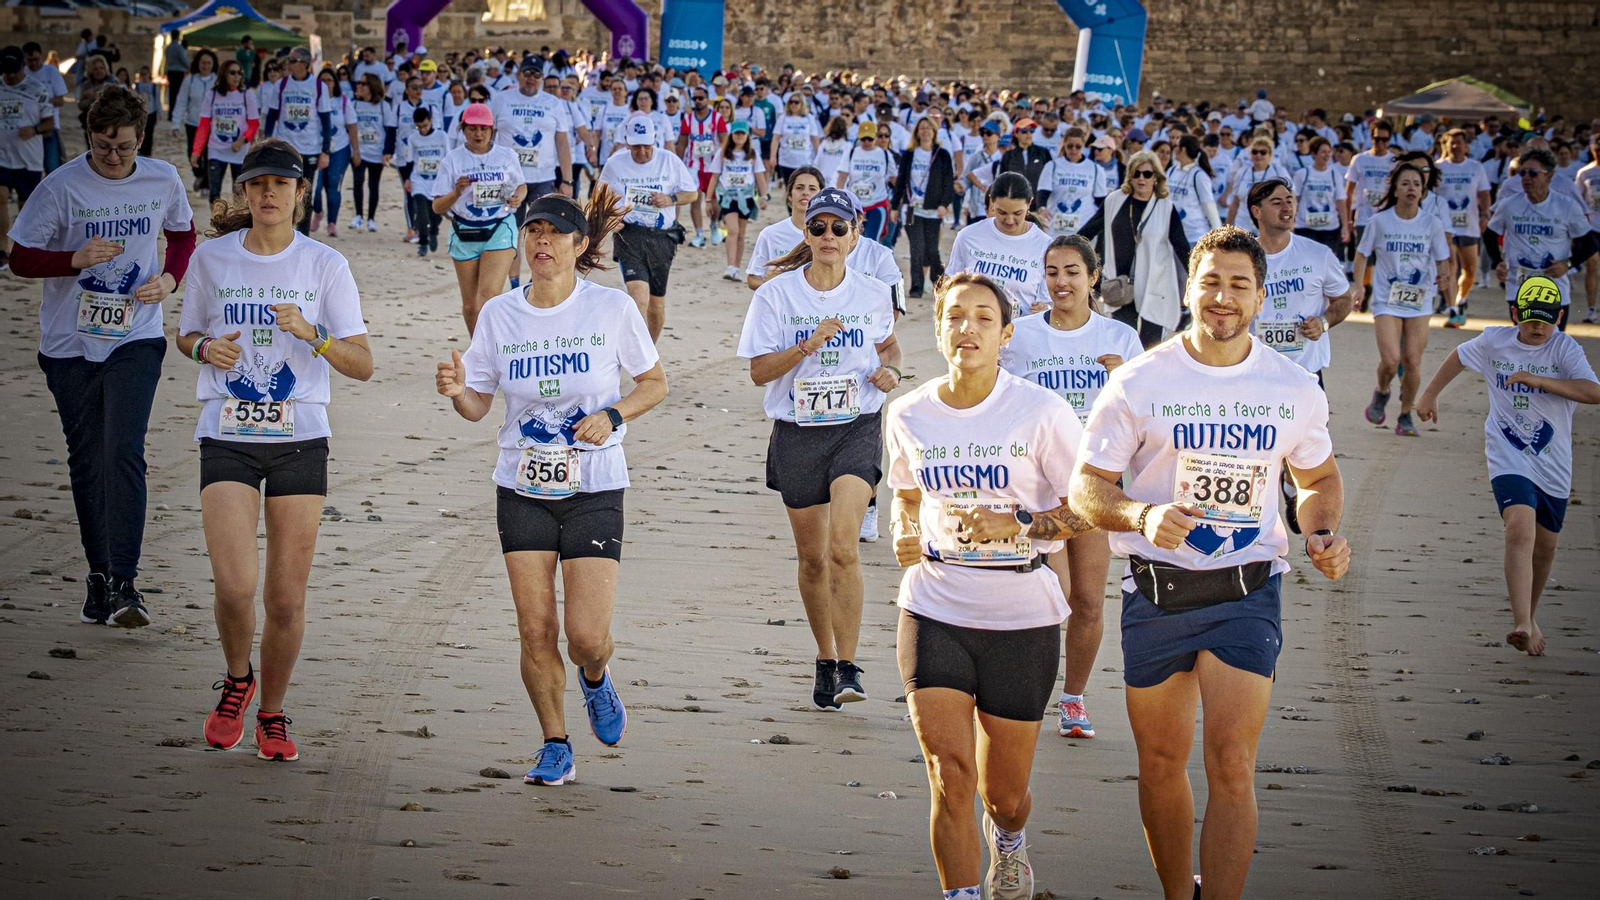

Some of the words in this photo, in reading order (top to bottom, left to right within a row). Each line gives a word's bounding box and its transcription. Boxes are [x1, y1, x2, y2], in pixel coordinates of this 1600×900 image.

[512, 109, 545, 118] AUTISMO
[79, 207, 110, 218] marcha
[114, 206, 120, 215] a
[123, 202, 147, 214] favor
[151, 199, 161, 211] del
[85, 216, 151, 239] AUTISMO
[1514, 224, 1554, 236] AUTISMO
[1386, 241, 1425, 253] AUTISMO
[974, 250, 997, 260] marcha
[1008, 255, 1027, 266] favor
[974, 260, 1028, 283] AUTISMO
[1281, 268, 1299, 277] favor
[1302, 264, 1313, 274] del
[218, 285, 253, 299] marcha
[258, 287, 265, 298] a
[270, 285, 299, 299] favor
[1397, 290, 1418, 302] 123
[1520, 286, 1558, 304] 46
[90, 305, 124, 325] 709
[791, 313, 819, 325] marcha
[864, 313, 872, 325] del
[503, 340, 538, 355] marcha
[543, 339, 550, 350] a
[555, 335, 585, 349] favor
[591, 333, 605, 346] del
[1265, 330, 1295, 343] 806
[509, 352, 590, 381] AUTISMO
[1032, 354, 1064, 369] marcha
[1069, 356, 1075, 365] a
[1079, 354, 1097, 366] fav
[1527, 363, 1548, 374] favor
[1038, 369, 1109, 390] AUTISMO
[808, 389, 847, 411] 717
[236, 400, 281, 423] 555
[1162, 401, 1211, 418] marcha
[1219, 404, 1226, 417] a
[1234, 401, 1271, 418] favor
[1279, 402, 1295, 420] del
[1173, 422, 1277, 451] AUTISMO
[953, 445, 960, 459] a
[967, 443, 1003, 459] favor
[1010, 441, 1029, 458] del
[526, 459, 568, 483] 556
[1191, 458, 1211, 466] MARCHA
[916, 464, 1009, 492] AUTISMO
[1194, 475, 1251, 506] 388
